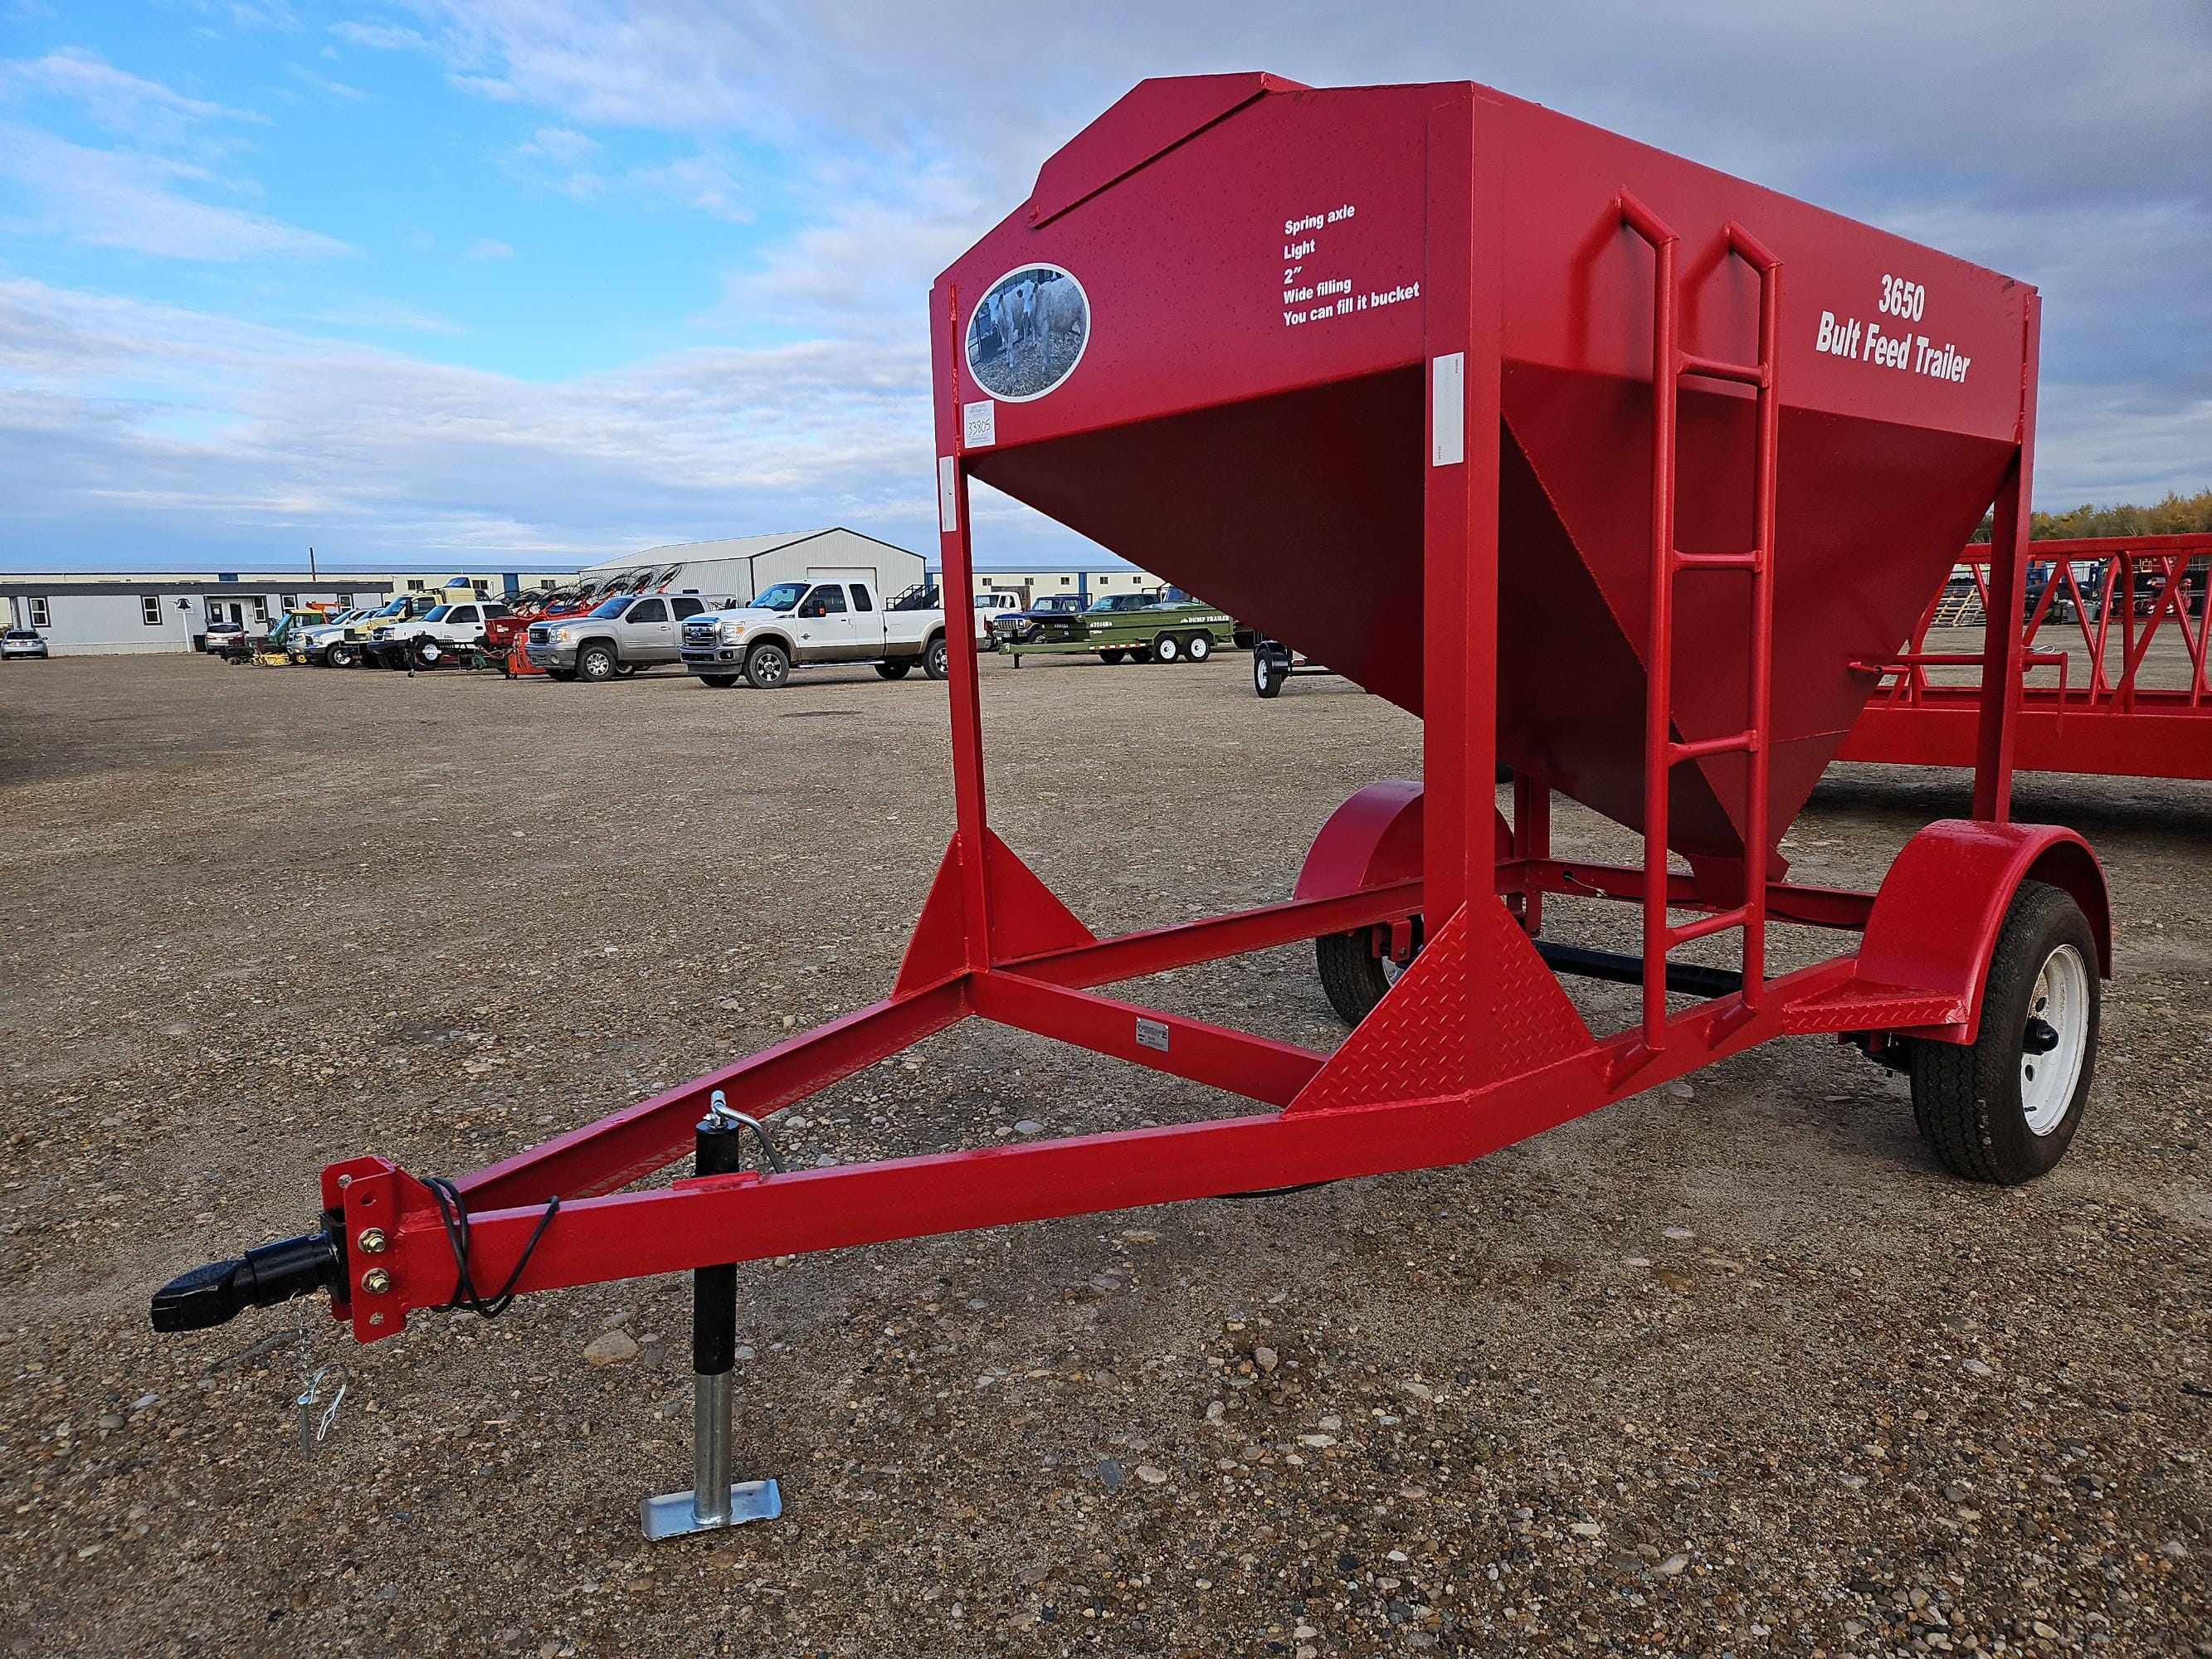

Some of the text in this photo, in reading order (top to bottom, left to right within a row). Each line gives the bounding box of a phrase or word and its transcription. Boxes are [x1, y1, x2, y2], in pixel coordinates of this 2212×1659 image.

[1284, 204, 1356, 236] Spring axle
[1284, 239, 1316, 260] Light
[1283, 278, 1352, 304] Wide filling
[1283, 281, 1420, 327] You can fill it bucket
[1878, 274, 1925, 322] 3650
[1815, 310, 1971, 383] Bult Feed Trailer
[968, 417, 992, 436] 33805
